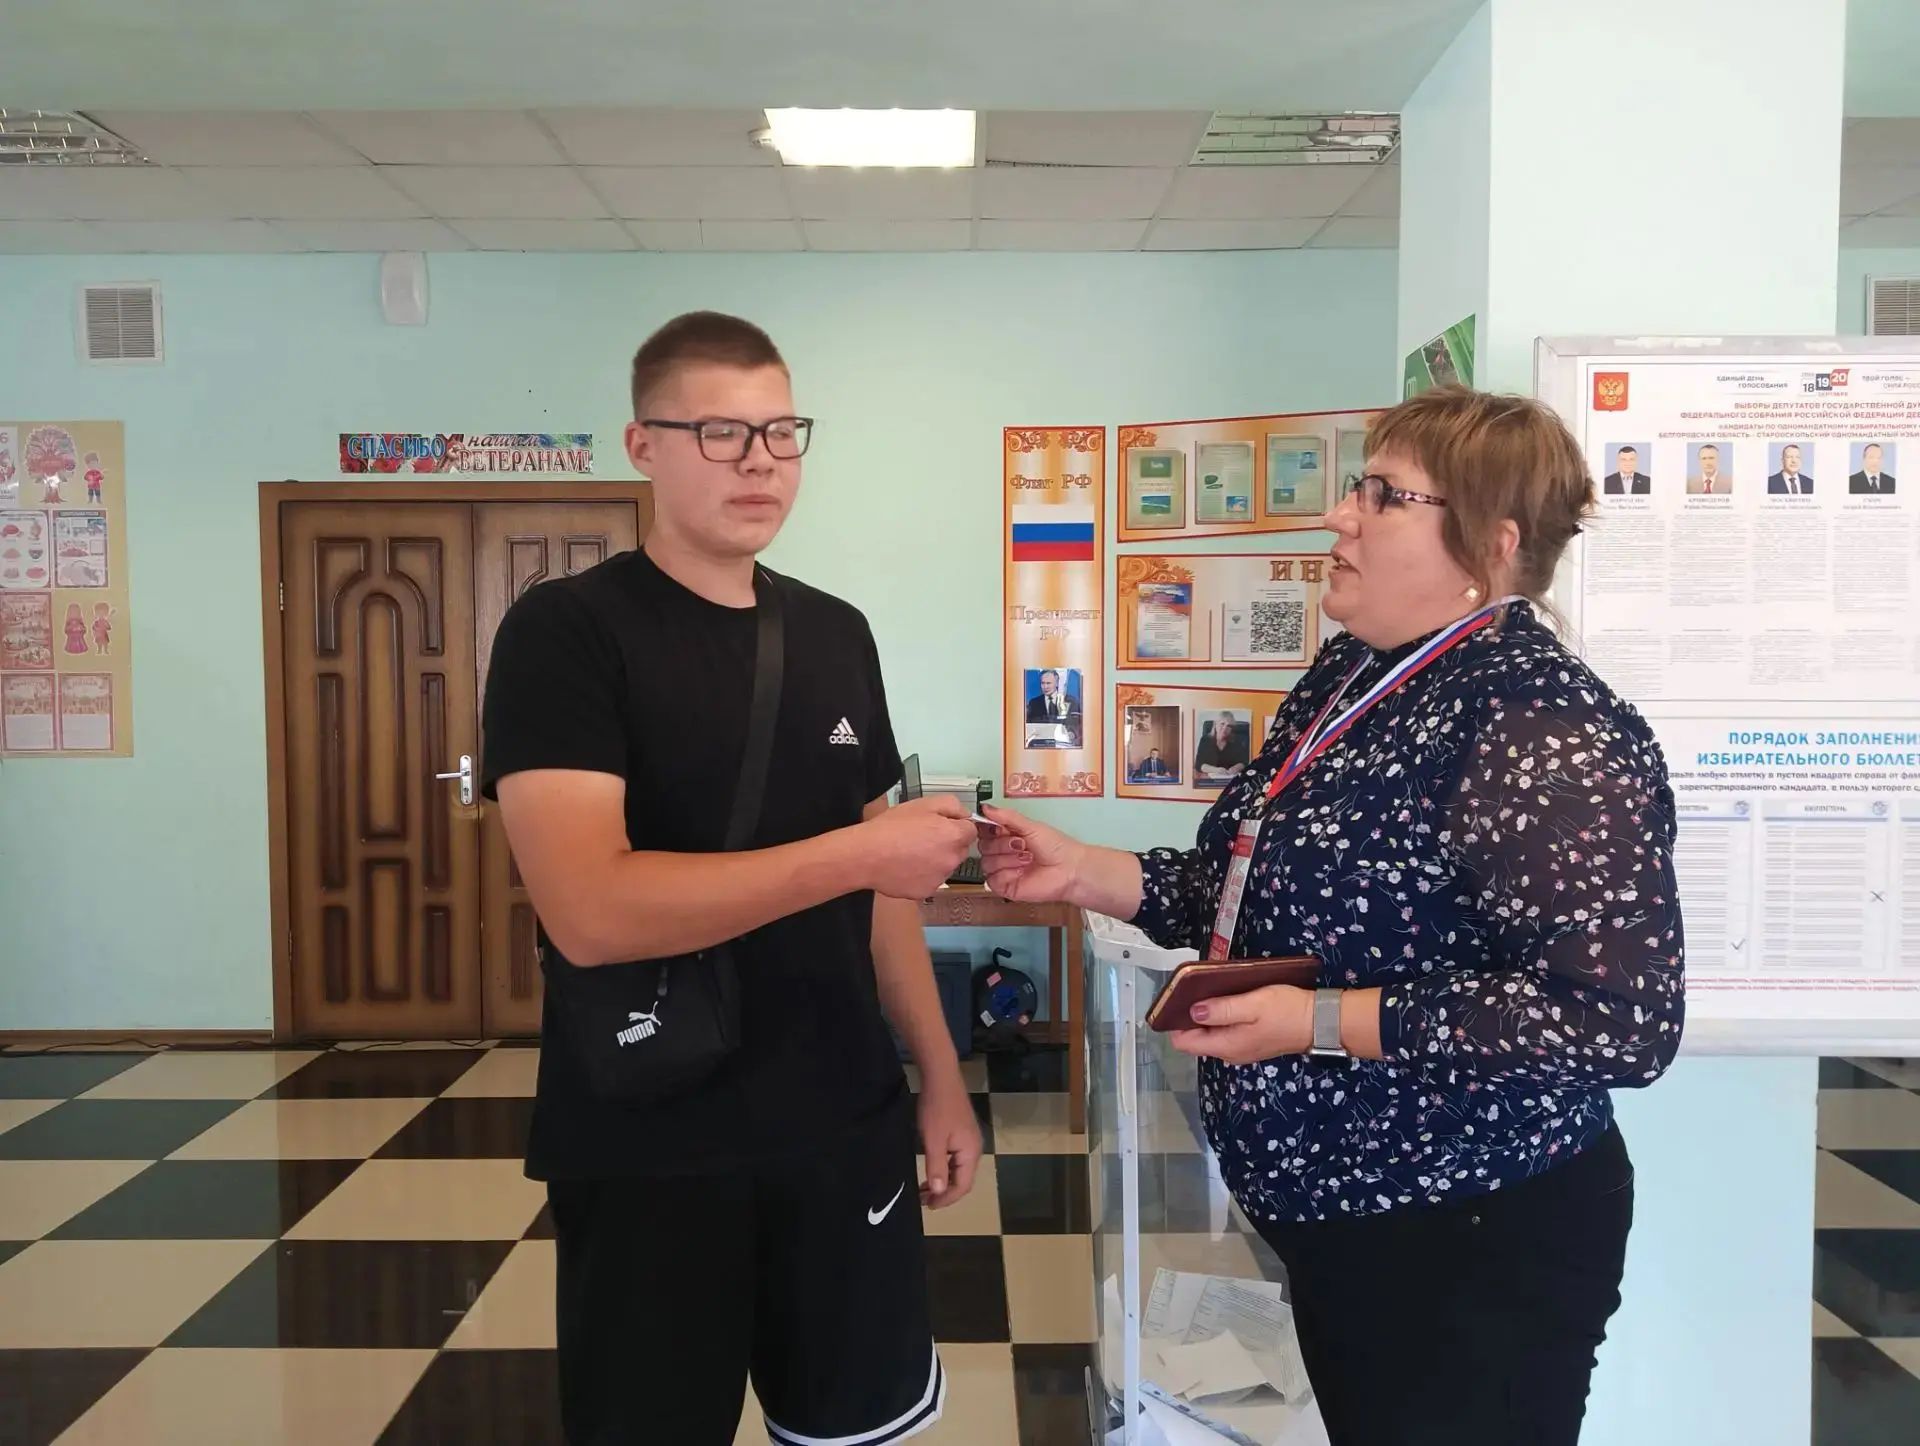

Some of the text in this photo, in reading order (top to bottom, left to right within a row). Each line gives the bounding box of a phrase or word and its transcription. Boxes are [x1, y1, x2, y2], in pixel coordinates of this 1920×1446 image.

[1816, 377, 1830, 389] 19
[1831, 373, 1847, 383] 20
[1803, 384, 1815, 392] 18
[1772, 402, 1820, 410] ДЕПУТАТОВ
[1822, 400, 1904, 410] ГОСУДАРСТВЕННОЙ
[1680, 411, 1746, 419] ФЕДЕРАЛЬНОГО
[1794, 409, 1851, 419] РОССИЙСКОЙ
[1853, 411, 1904, 419] ФЕДЕРАЦИИ
[1718, 423, 1764, 431] КАНДИДАТЫ
[467, 434, 540, 448] нашим
[348, 436, 447, 459] СПАСИБО
[459, 449, 591, 473] ВЕТЕРАНАМ!
[1010, 473, 1093, 490] Флаг РФ
[1009, 605, 1101, 624] Президент
[829, 734, 860, 746] adidas
[1728, 732, 1809, 746] ПОРЯДОК
[1697, 753, 1850, 765] ИЗБИРАТЕЛЬНОГО
[1697, 771, 1727, 780] любую
[616, 1020, 656, 1047] PUMA
